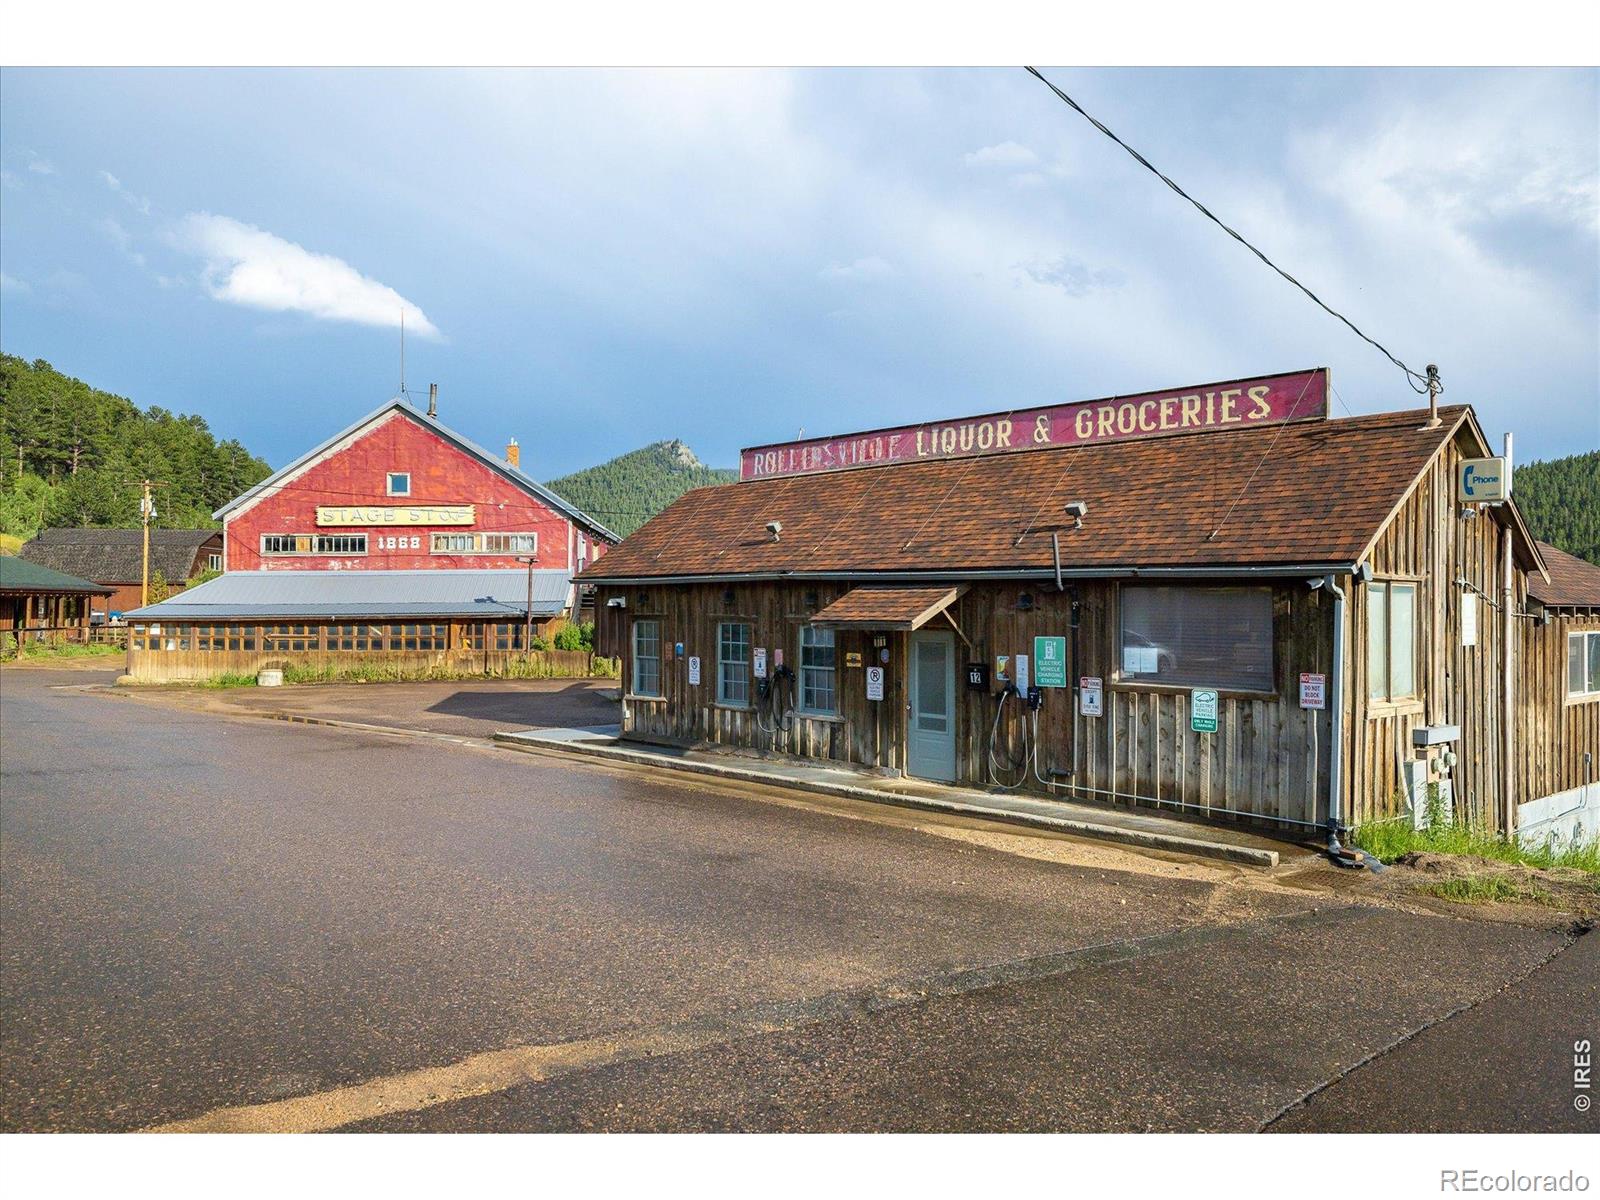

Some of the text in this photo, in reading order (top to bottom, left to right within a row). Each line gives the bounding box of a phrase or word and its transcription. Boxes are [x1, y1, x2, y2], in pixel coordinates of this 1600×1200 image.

[916, 419, 1013, 457] LIQUOR
[1033, 414, 1052, 444] &
[1074, 385, 1271, 439] GROCERIES
[323, 509, 466, 523] STAGE STOP
[970, 672, 980, 683] 12
